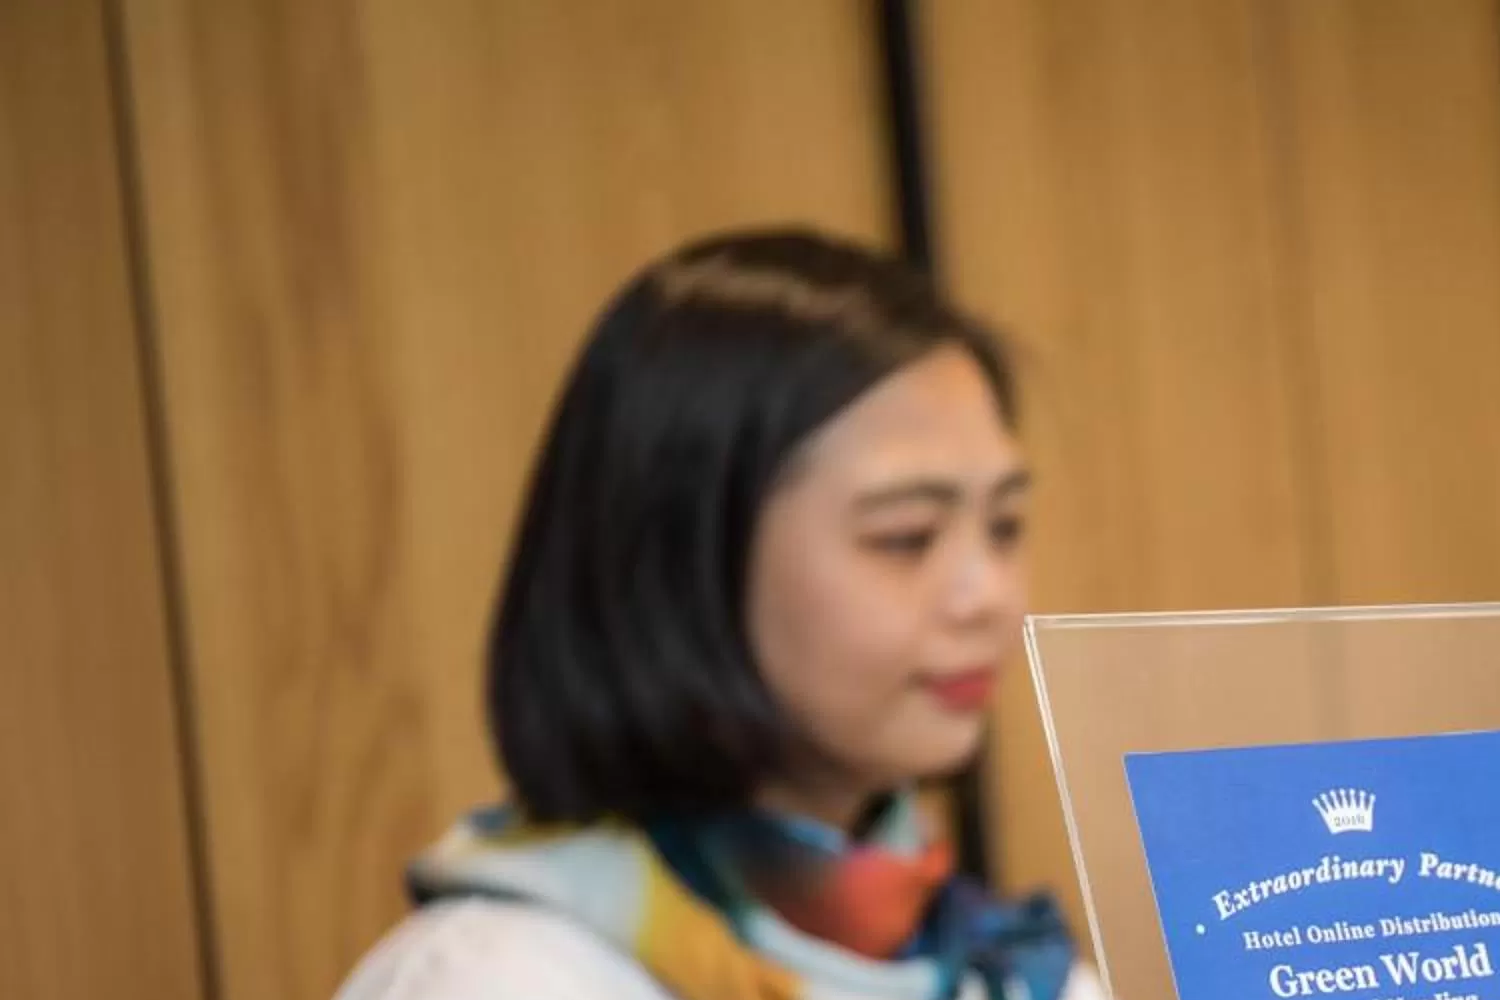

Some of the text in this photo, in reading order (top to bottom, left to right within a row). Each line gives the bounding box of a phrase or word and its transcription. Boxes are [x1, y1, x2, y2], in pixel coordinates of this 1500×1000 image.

[1212, 855, 1405, 920] Extraordinary
[1243, 926, 1301, 950] Hotel
[1306, 920, 1375, 943] Online
[1269, 943, 1494, 998] Green World
